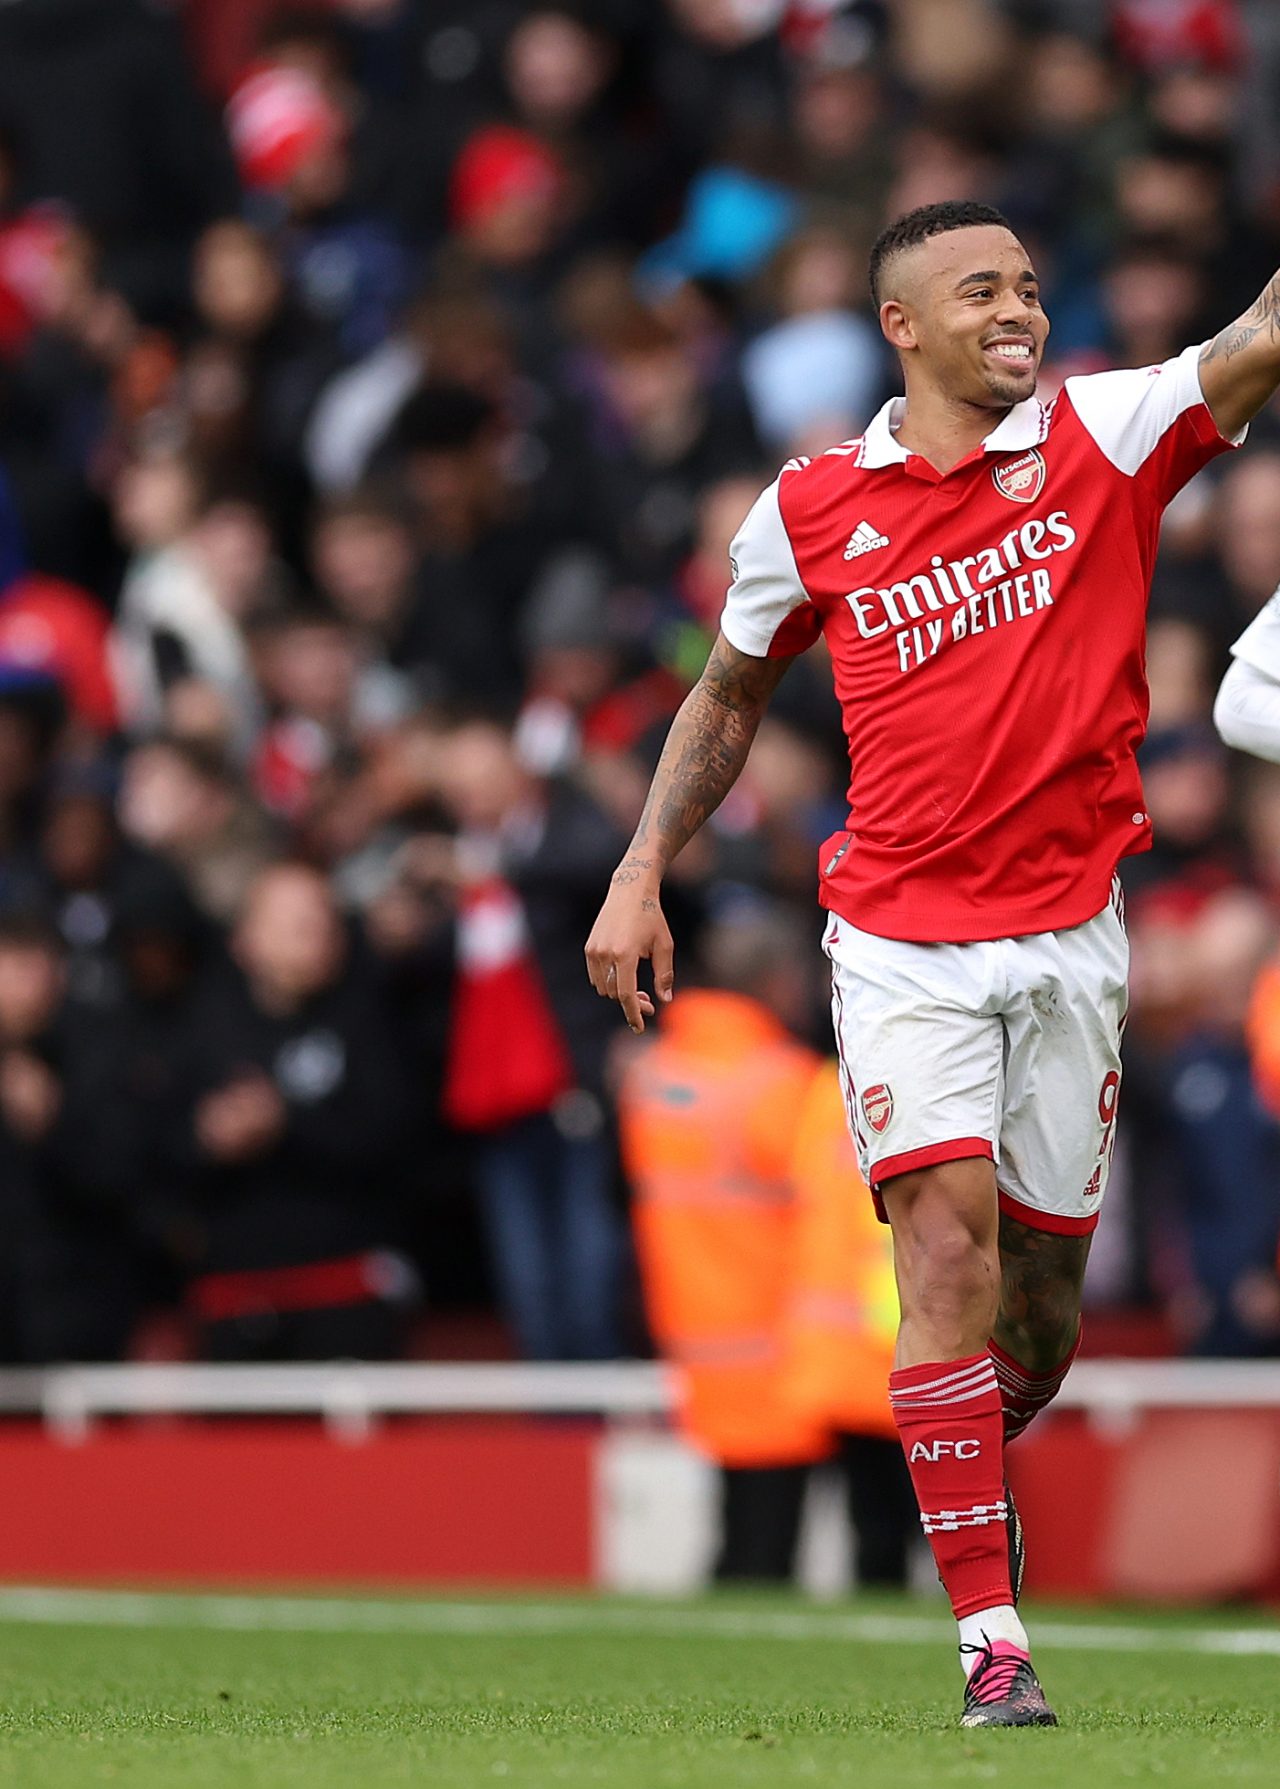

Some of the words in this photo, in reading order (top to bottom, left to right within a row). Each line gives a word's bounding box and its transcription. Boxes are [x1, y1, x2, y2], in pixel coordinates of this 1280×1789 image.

[999, 453, 1035, 478] Arsenal
[843, 535, 891, 562] adidas
[844, 511, 1077, 640] Emirates
[896, 618, 943, 673] FLY
[951, 568, 1054, 643] BETTER
[1098, 1070, 1120, 1156] 9
[910, 1439, 981, 1463] AFC
